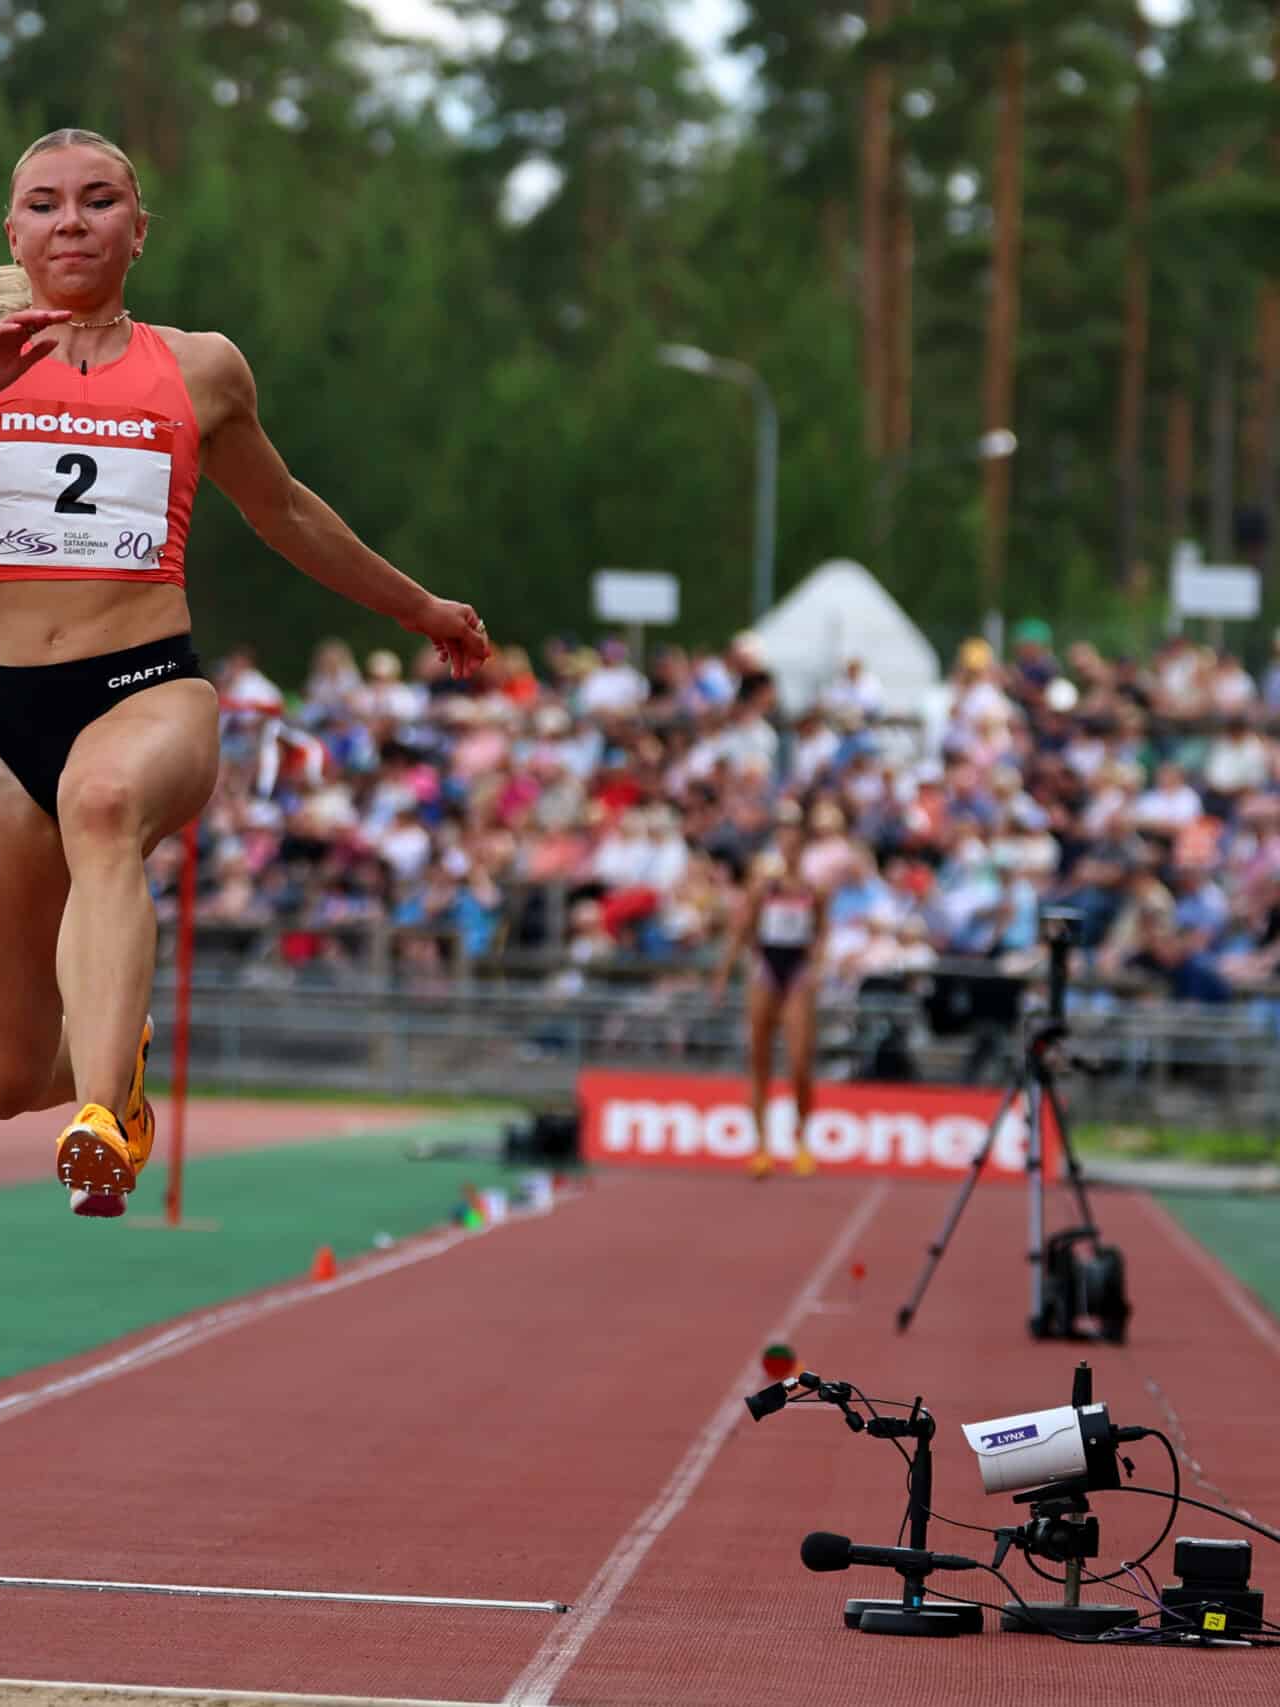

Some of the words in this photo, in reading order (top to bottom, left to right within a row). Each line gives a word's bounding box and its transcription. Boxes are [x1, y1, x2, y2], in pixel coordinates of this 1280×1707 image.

[1, 411, 156, 440] motonet
[54, 452, 98, 515] 2
[114, 531, 153, 559] 80
[108, 665, 165, 688] CRAFT
[604, 1097, 1031, 1173] motonet
[997, 1430, 1025, 1444] LYNX
